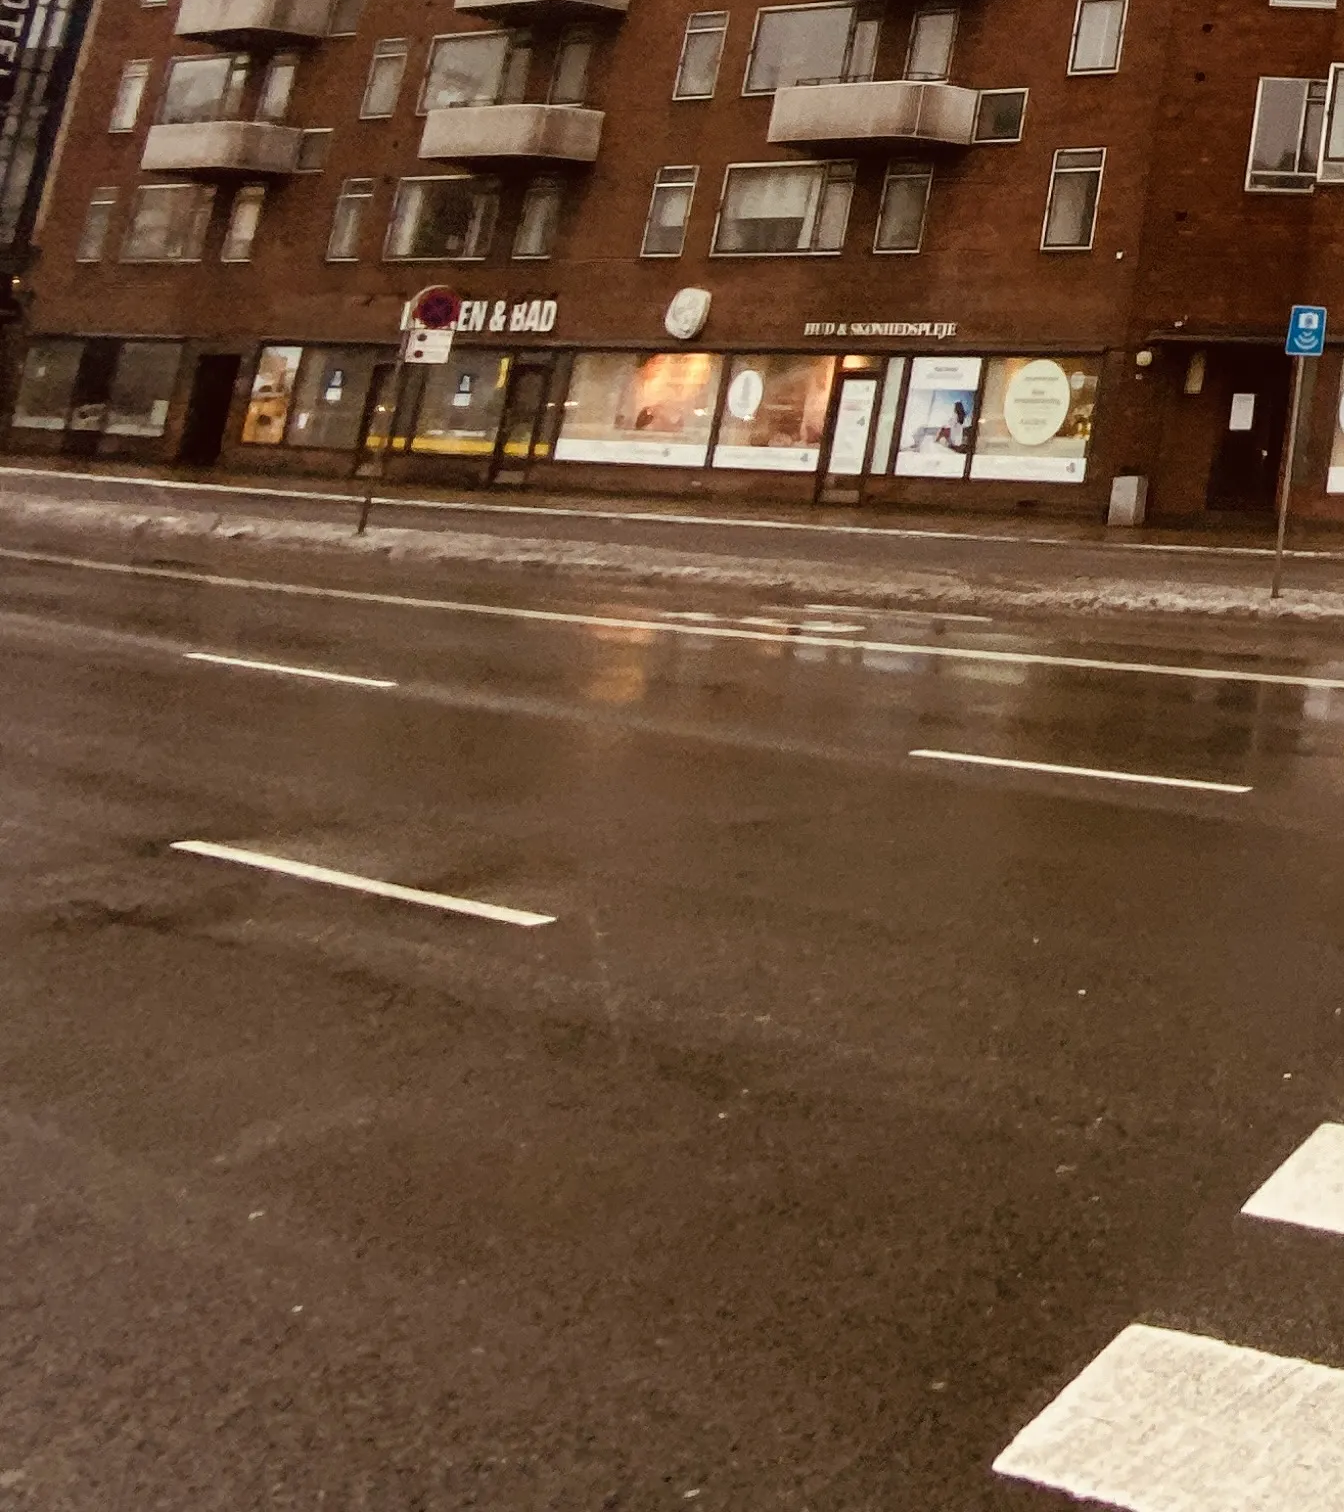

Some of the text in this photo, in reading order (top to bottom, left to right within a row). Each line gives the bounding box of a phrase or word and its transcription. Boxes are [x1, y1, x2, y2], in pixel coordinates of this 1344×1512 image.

[489, 300, 507, 332] &
[510, 300, 557, 332] BAD
[804, 322, 836, 336] HUD
[836, 323, 848, 336] &
